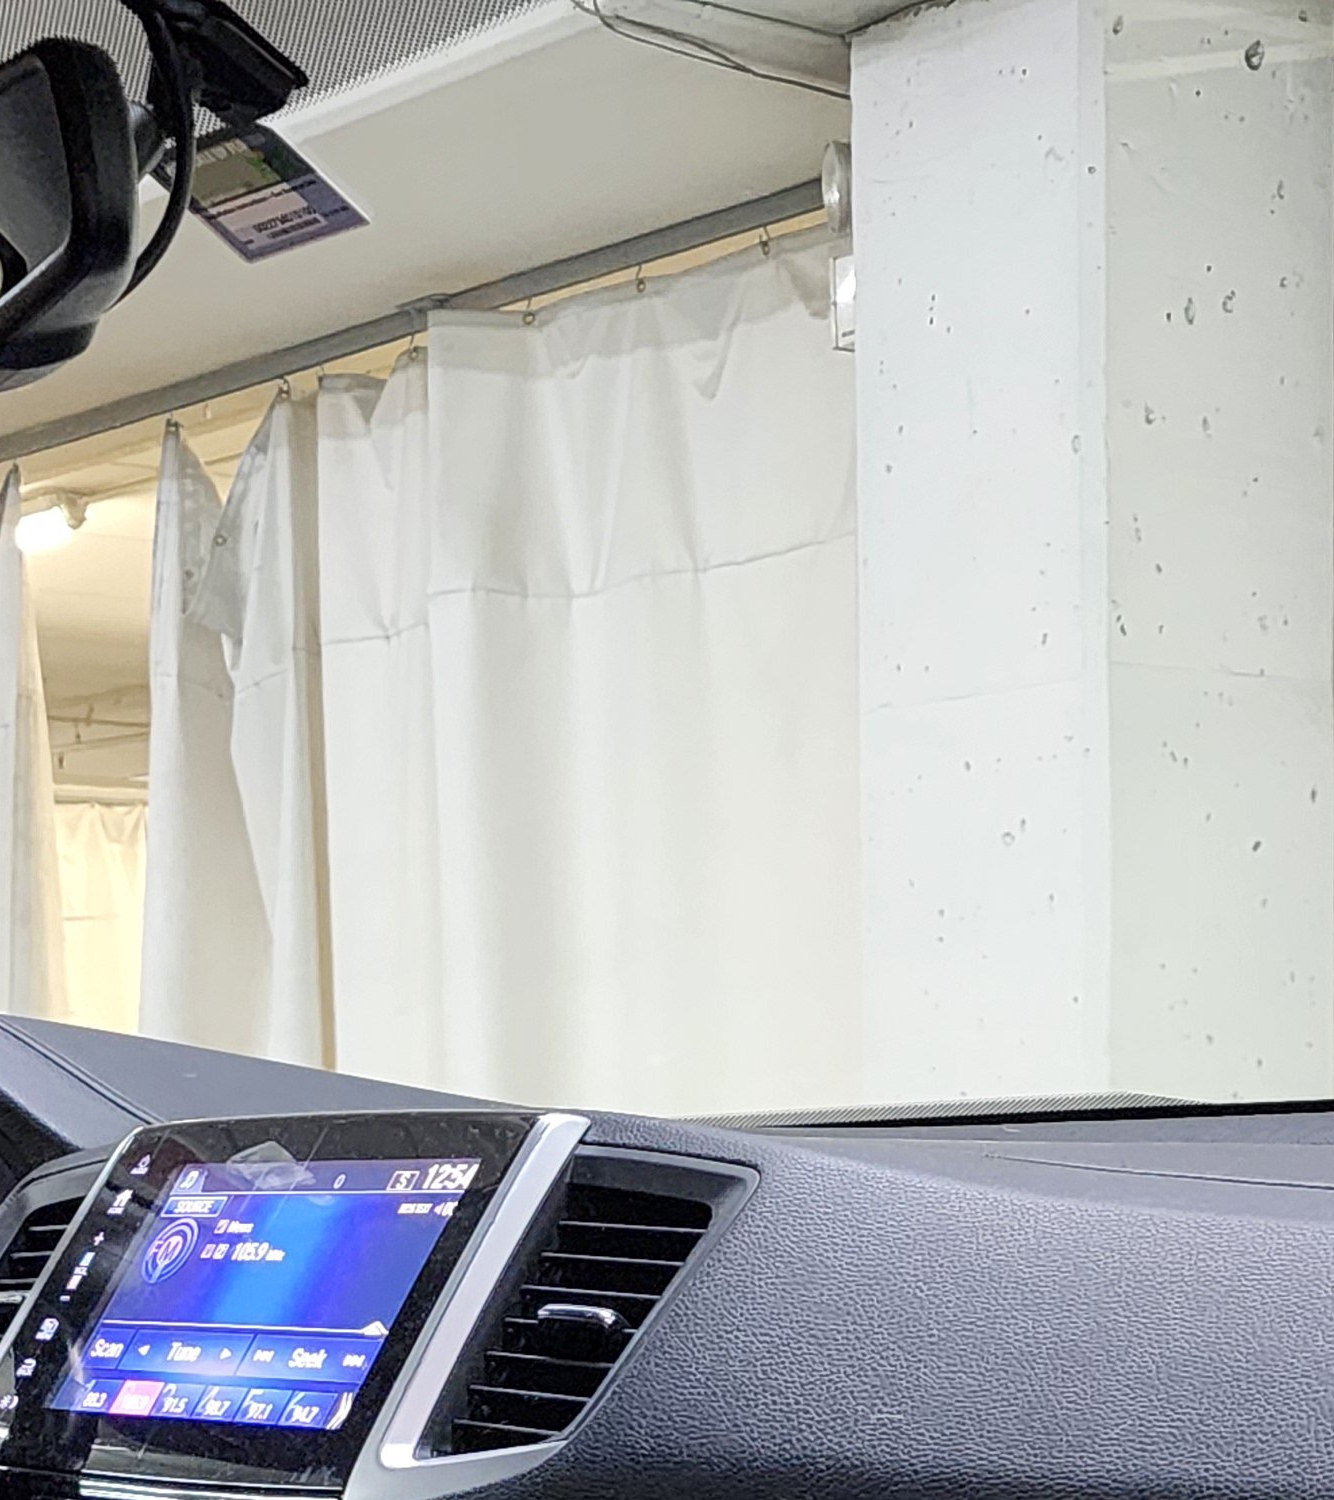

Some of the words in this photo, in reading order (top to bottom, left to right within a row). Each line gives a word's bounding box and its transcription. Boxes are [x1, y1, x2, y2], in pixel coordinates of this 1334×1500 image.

[173, 1200, 214, 1213] SOURCE
[90, 1339, 124, 1358] Scan
[166, 1342, 202, 1362] Tune
[288, 1347, 328, 1369] Seek
